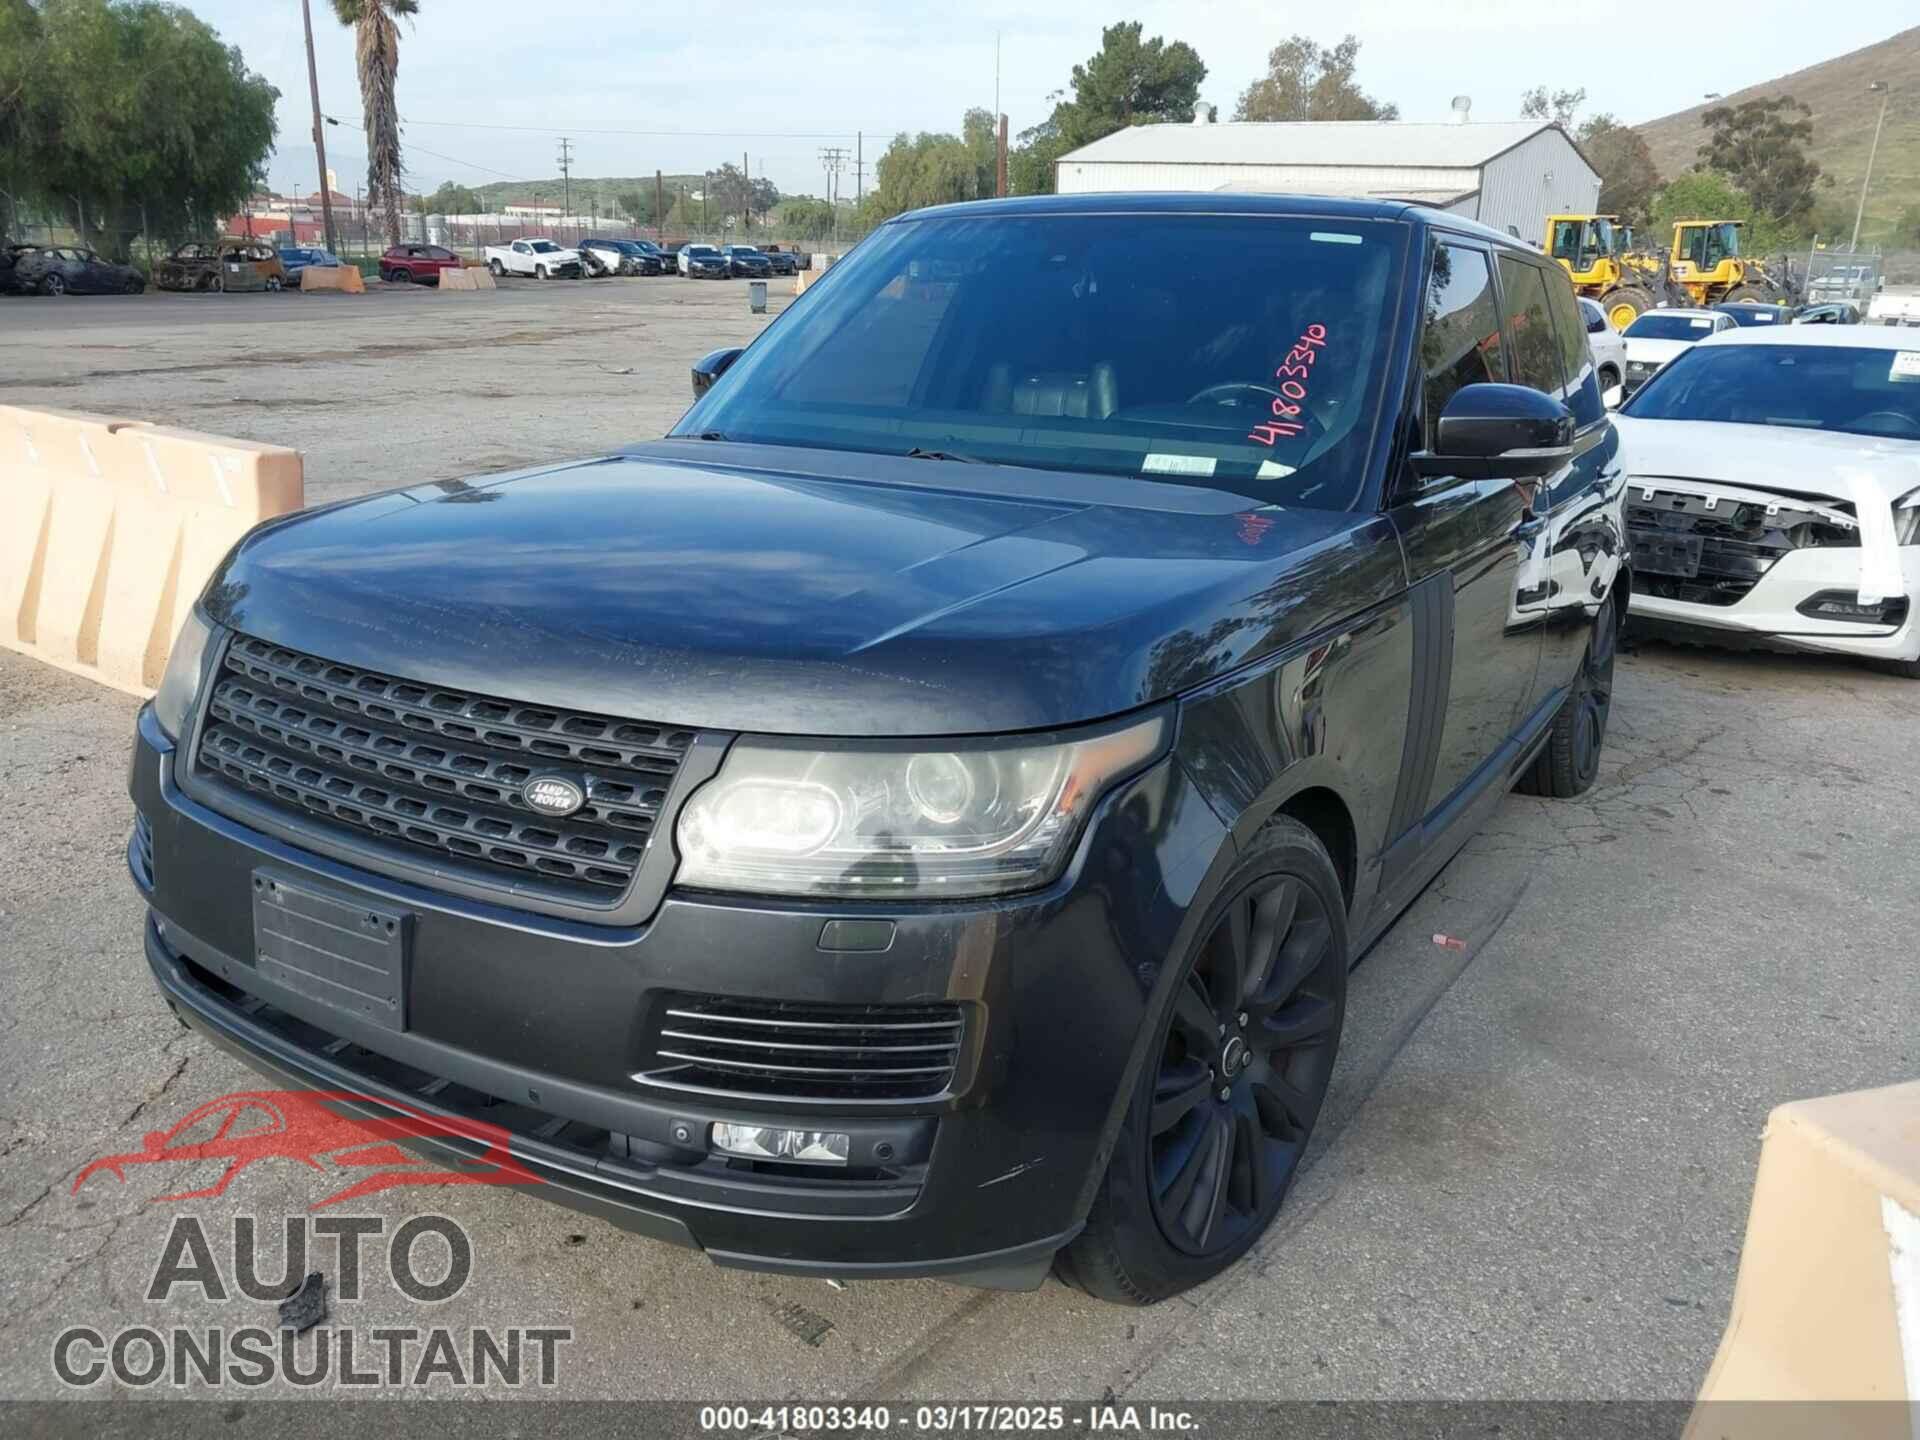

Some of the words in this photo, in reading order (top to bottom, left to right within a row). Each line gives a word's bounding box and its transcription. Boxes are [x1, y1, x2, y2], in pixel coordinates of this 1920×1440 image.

[1247, 323, 1327, 446] 41803340
[534, 782, 564, 796] LAND
[535, 793, 570, 809] ROVER
